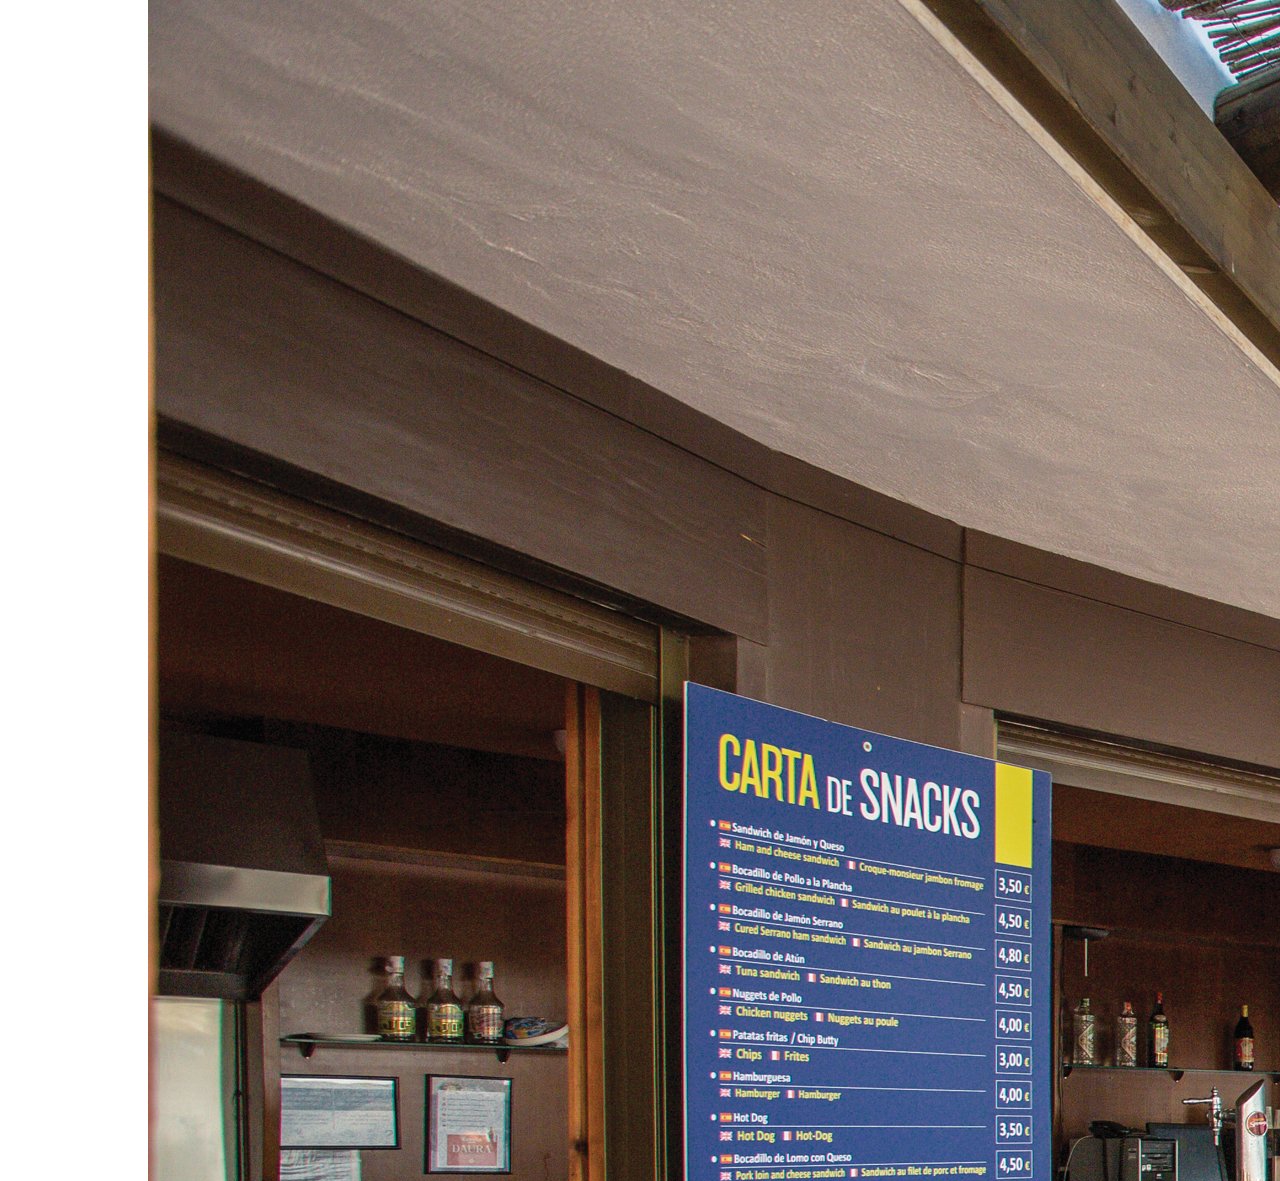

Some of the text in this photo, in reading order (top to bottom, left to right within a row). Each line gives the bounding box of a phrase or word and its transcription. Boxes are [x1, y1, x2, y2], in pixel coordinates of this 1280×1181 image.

[719, 733, 979, 839] CARTA DE SNACKS
[731, 822, 844, 852] Sandwich de Jamón y Queso
[734, 839, 839, 867] Ham and cheese sandwich
[732, 863, 770, 879] Bocadillo
[771, 870, 782, 881] de
[784, 872, 804, 884] Pollo
[812, 876, 820, 887] la
[821, 878, 852, 892] Plancha
[858, 861, 983, 891] Croque-monsieur jambon fromage
[734, 881, 835, 905] Grilled chicken sandwich
[732, 904, 843, 928] Bocadillo de Jamón Serrano
[851, 899, 970, 923] Sandwich au poulet à la plancha
[734, 922, 846, 945] Cured Serrano ham sandwich
[732, 946, 804, 963] Bocadillo de Atún
[863, 938, 972, 959] Sandwich au jambon Serrano
[735, 964, 800, 980] Tuna sandwich
[819, 973, 891, 989] Sandwich au thon
[732, 988, 801, 1003] Nuggets de Pollo
[735, 1005, 808, 1022] Chicken nuggets
[827, 1012, 898, 1027] Nuggets au poule
[732, 1029, 764, 1041] Patatas
[765, 1030, 787, 1042] fritas
[797, 1033, 815, 1045] Chip
[816, 1034, 838, 1046] Butty
[736, 1047, 762, 1061] Chips
[784, 1050, 809, 1062] Frites
[732, 1071, 790, 1084] Hamburguesa
[734, 1088, 780, 1100] Hamburger
[798, 1089, 841, 1101] Hamburger
[733, 1112, 767, 1124] Hot Dog
[737, 1130, 775, 1143] Hot Dog
[795, 1130, 833, 1142] Hot-Dog
[452, 1143, 492, 1154] DAURA
[733, 1152, 851, 1163] Bocadillo de Lomo con Queso
[735, 1167, 845, 1180] Pork loin and cheese sandwich
[860, 1164, 986, 1177] Sandwich au filet de porc et fromage
